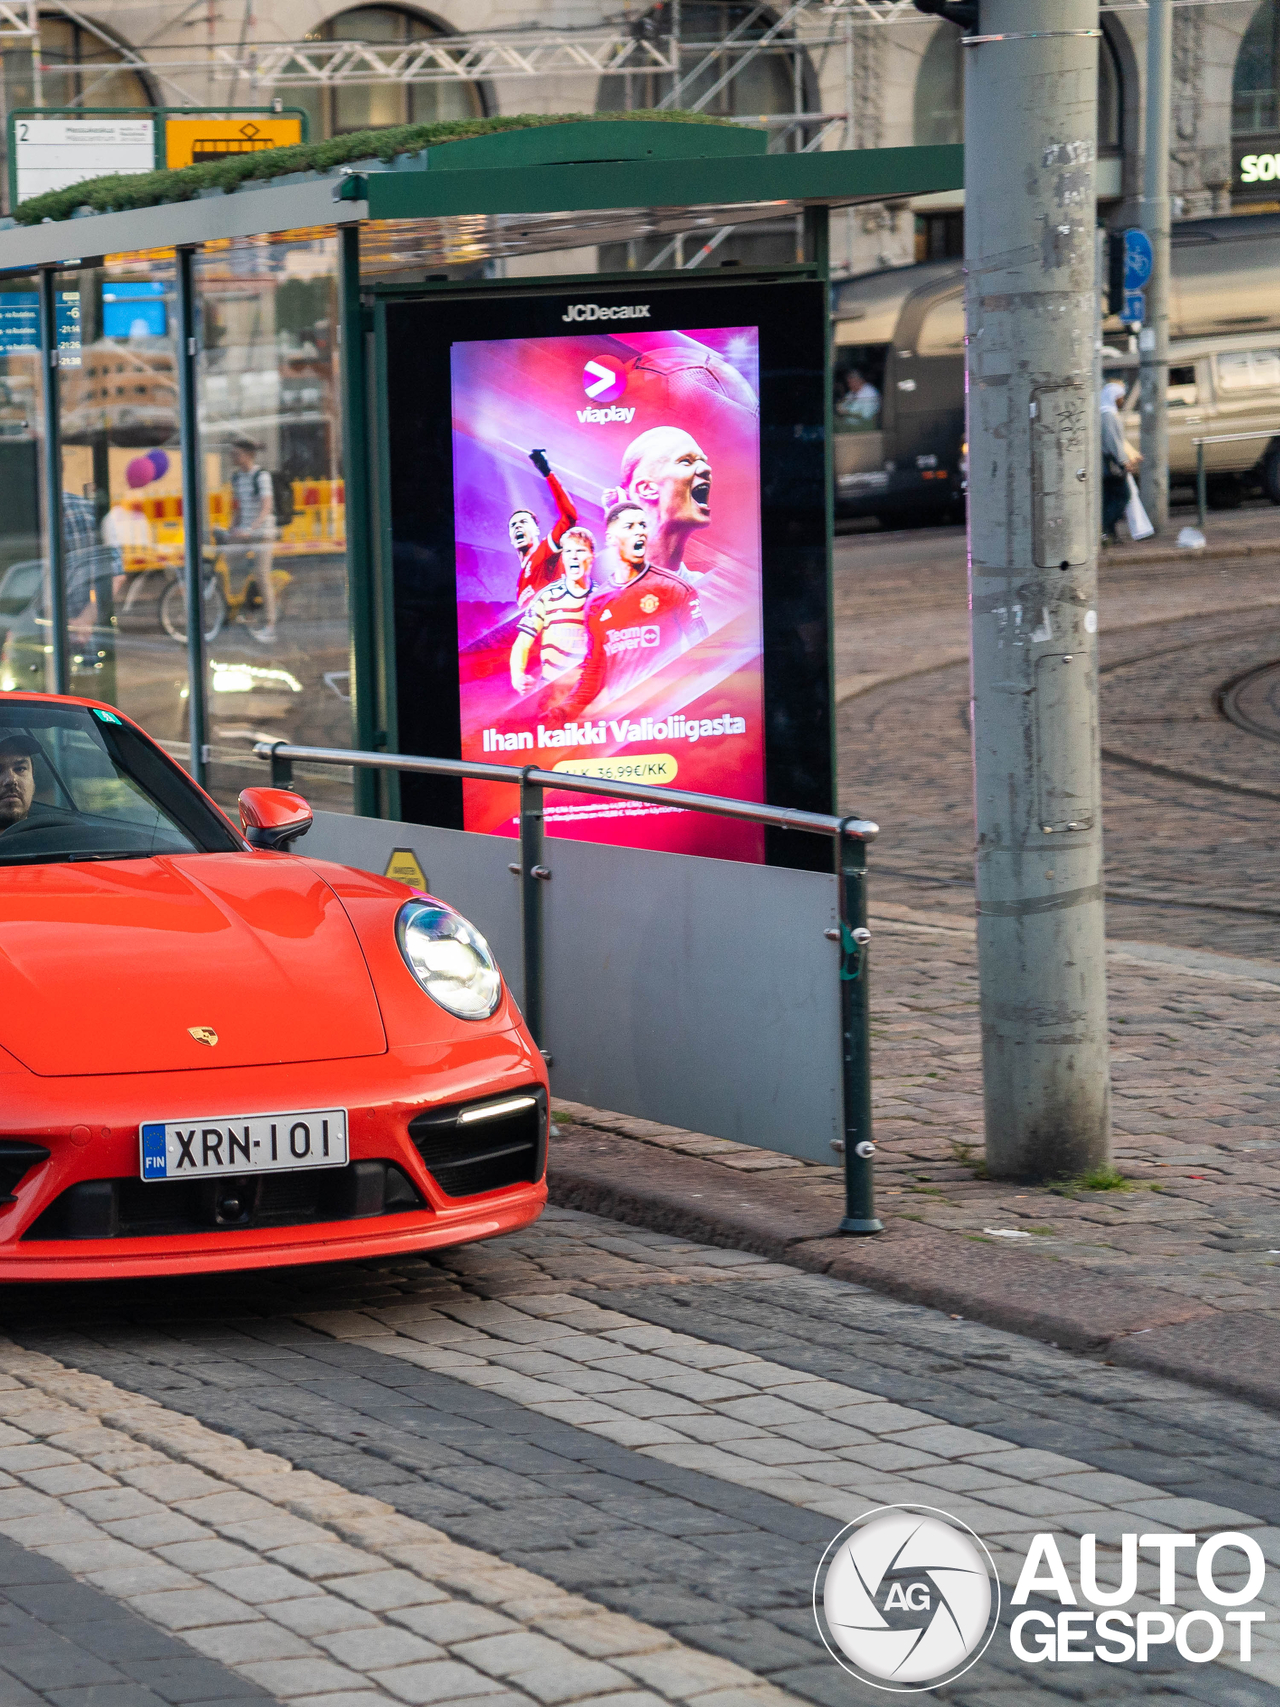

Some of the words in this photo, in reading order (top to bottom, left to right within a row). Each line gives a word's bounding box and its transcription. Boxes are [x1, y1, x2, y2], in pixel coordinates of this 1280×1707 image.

[20, 124, 29, 141] 2
[1240, 153, 1280, 183] SO
[562, 304, 651, 322] JCDecaux
[576, 406, 636, 425] viaplay
[605, 627, 641, 643] Team
[482, 727, 533, 752] Ihan
[537, 722, 607, 748] kaikki
[608, 713, 746, 743] Valioliigasta
[145, 1156, 165, 1168] FIN
[175, 1120, 329, 1168] XRN-101
